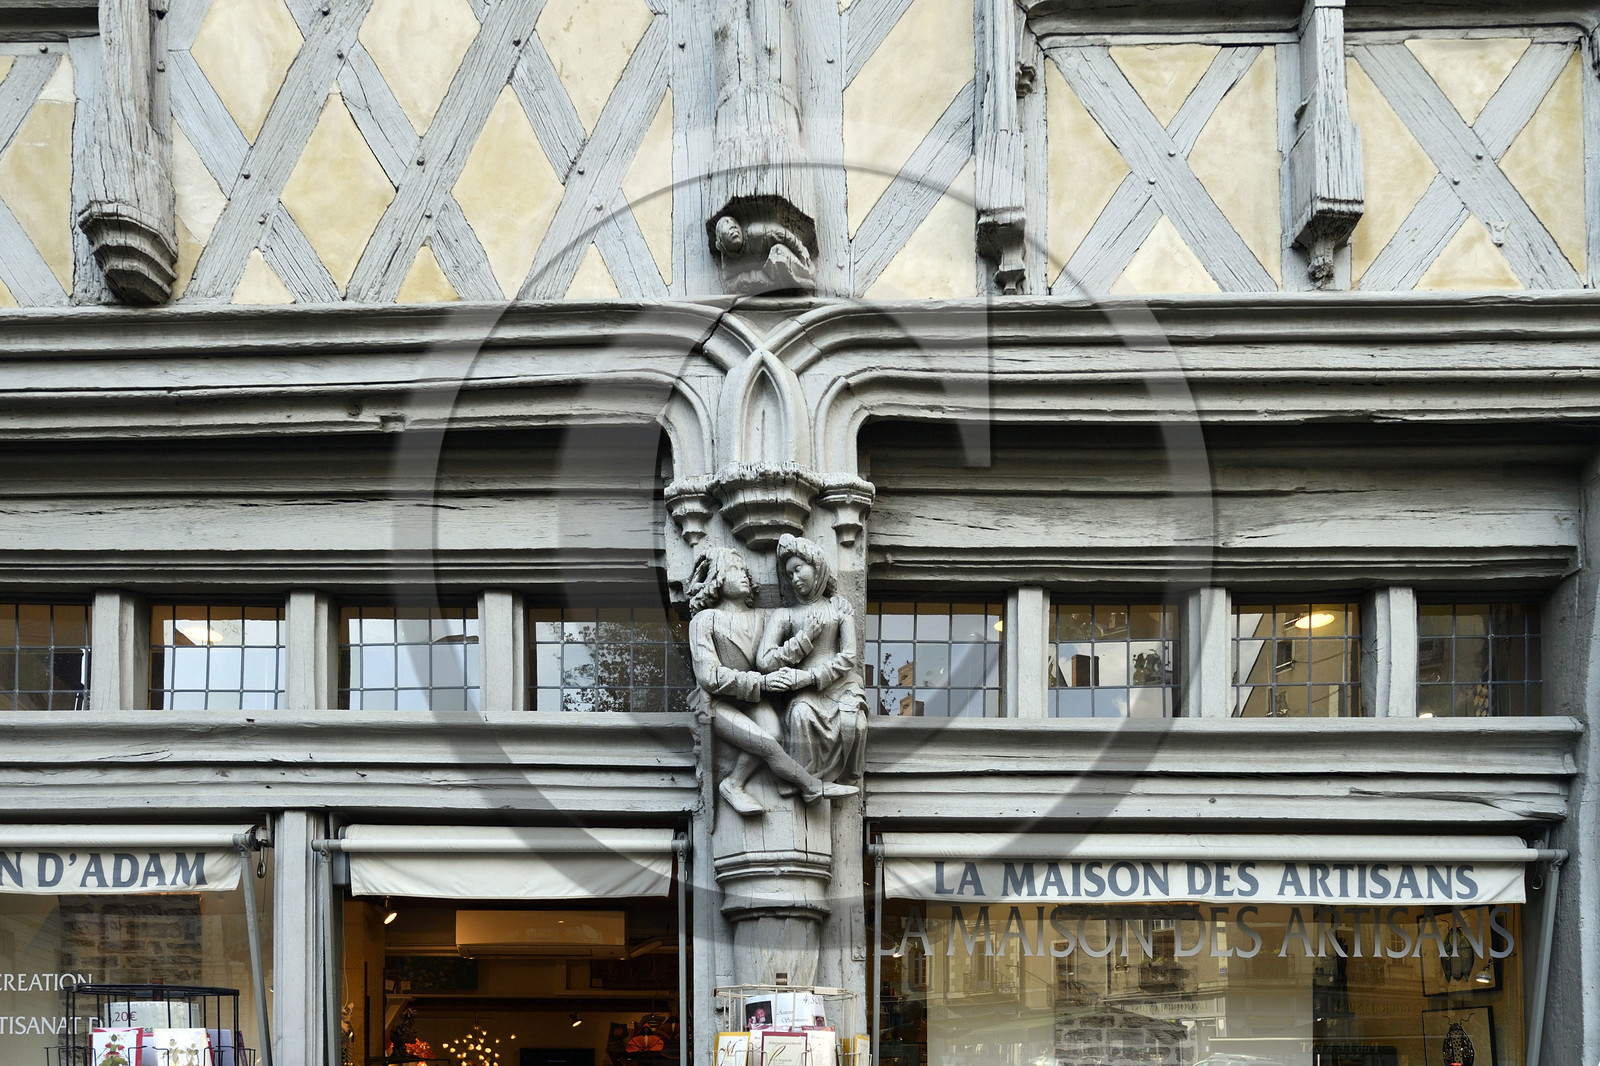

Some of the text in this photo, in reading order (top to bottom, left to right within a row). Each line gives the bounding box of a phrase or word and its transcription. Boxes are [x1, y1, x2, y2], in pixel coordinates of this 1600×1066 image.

[934, 862, 1477, 899] LA MAISON DES ARTISANS
[946, 905, 1154, 959] MAISON
[1174, 907, 1262, 959] DES
[1277, 907, 1516, 959] ARTISANS
[0, 973, 92, 992] REATION
